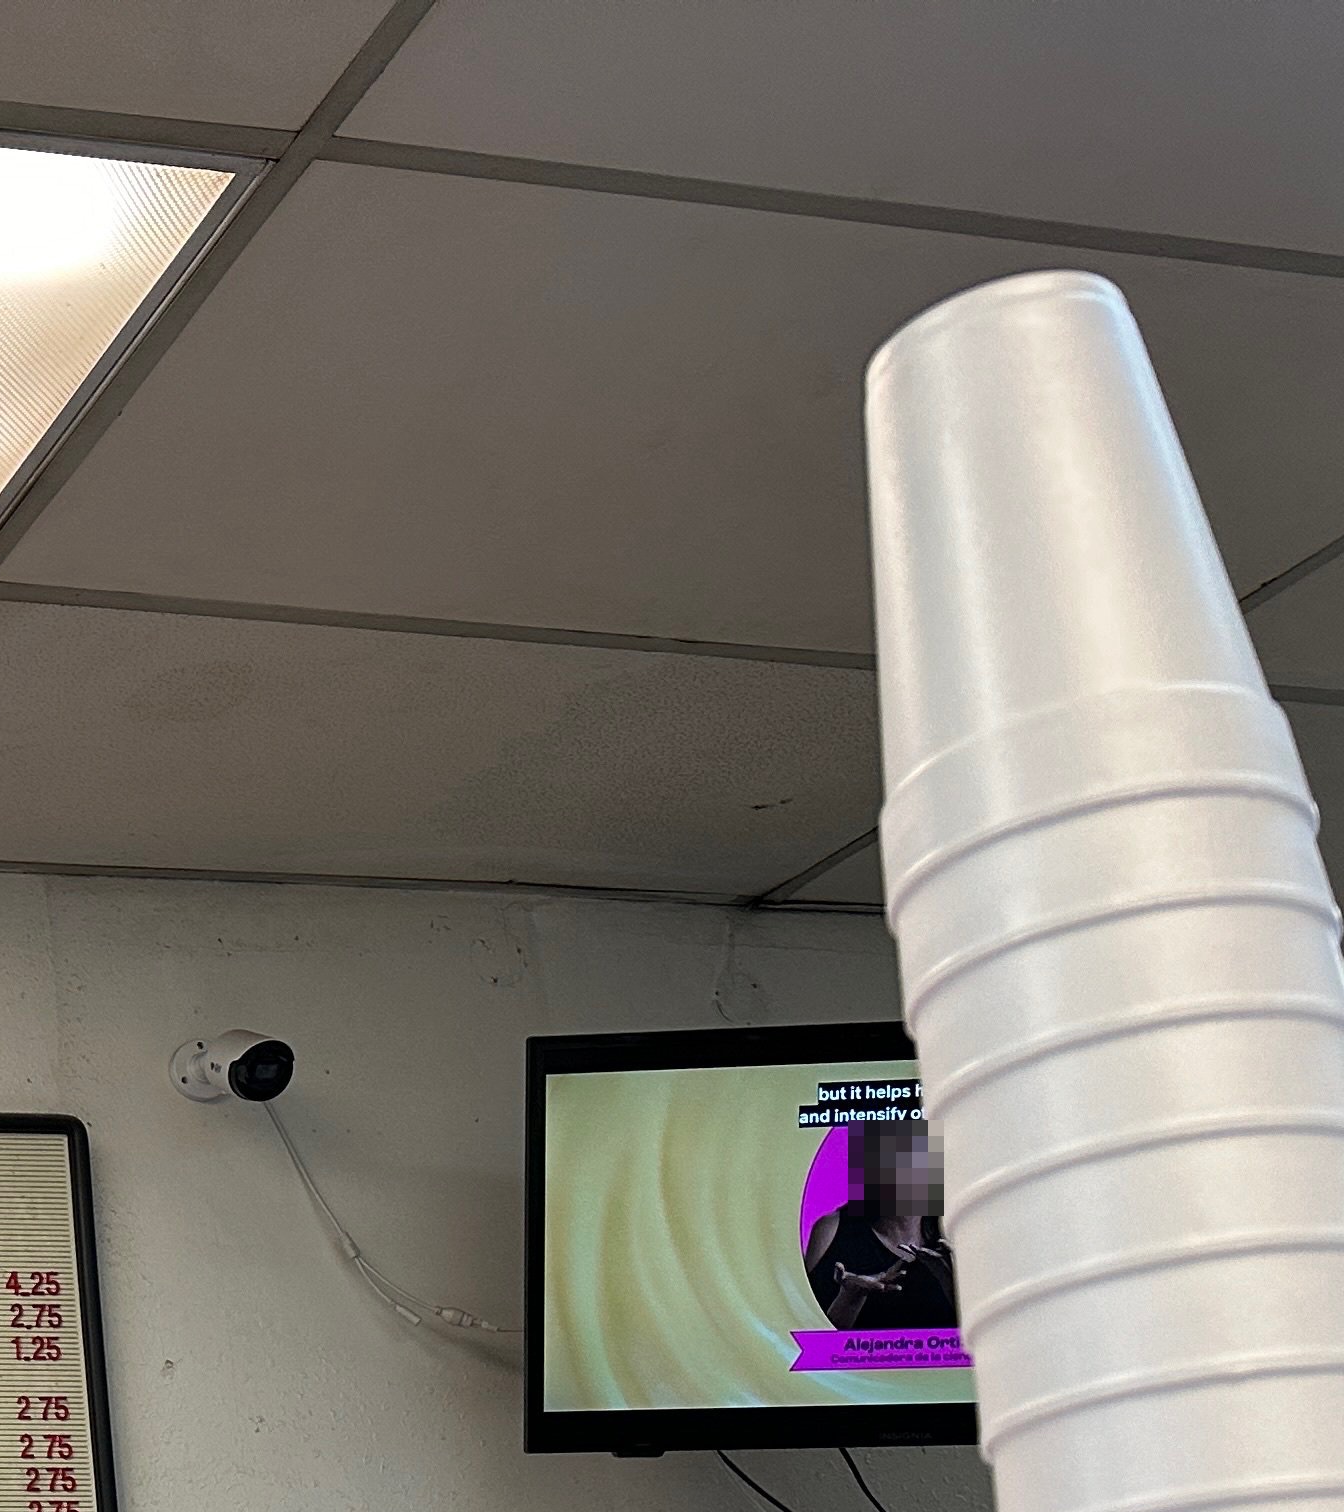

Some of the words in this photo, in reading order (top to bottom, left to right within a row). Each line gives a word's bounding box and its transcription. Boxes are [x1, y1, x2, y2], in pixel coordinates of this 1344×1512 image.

[818, 1085, 847, 1102] but
[850, 1085, 863, 1101] it
[865, 1083, 912, 1103] helps
[798, 1108, 831, 1125] and
[834, 1106, 908, 1122] intensify
